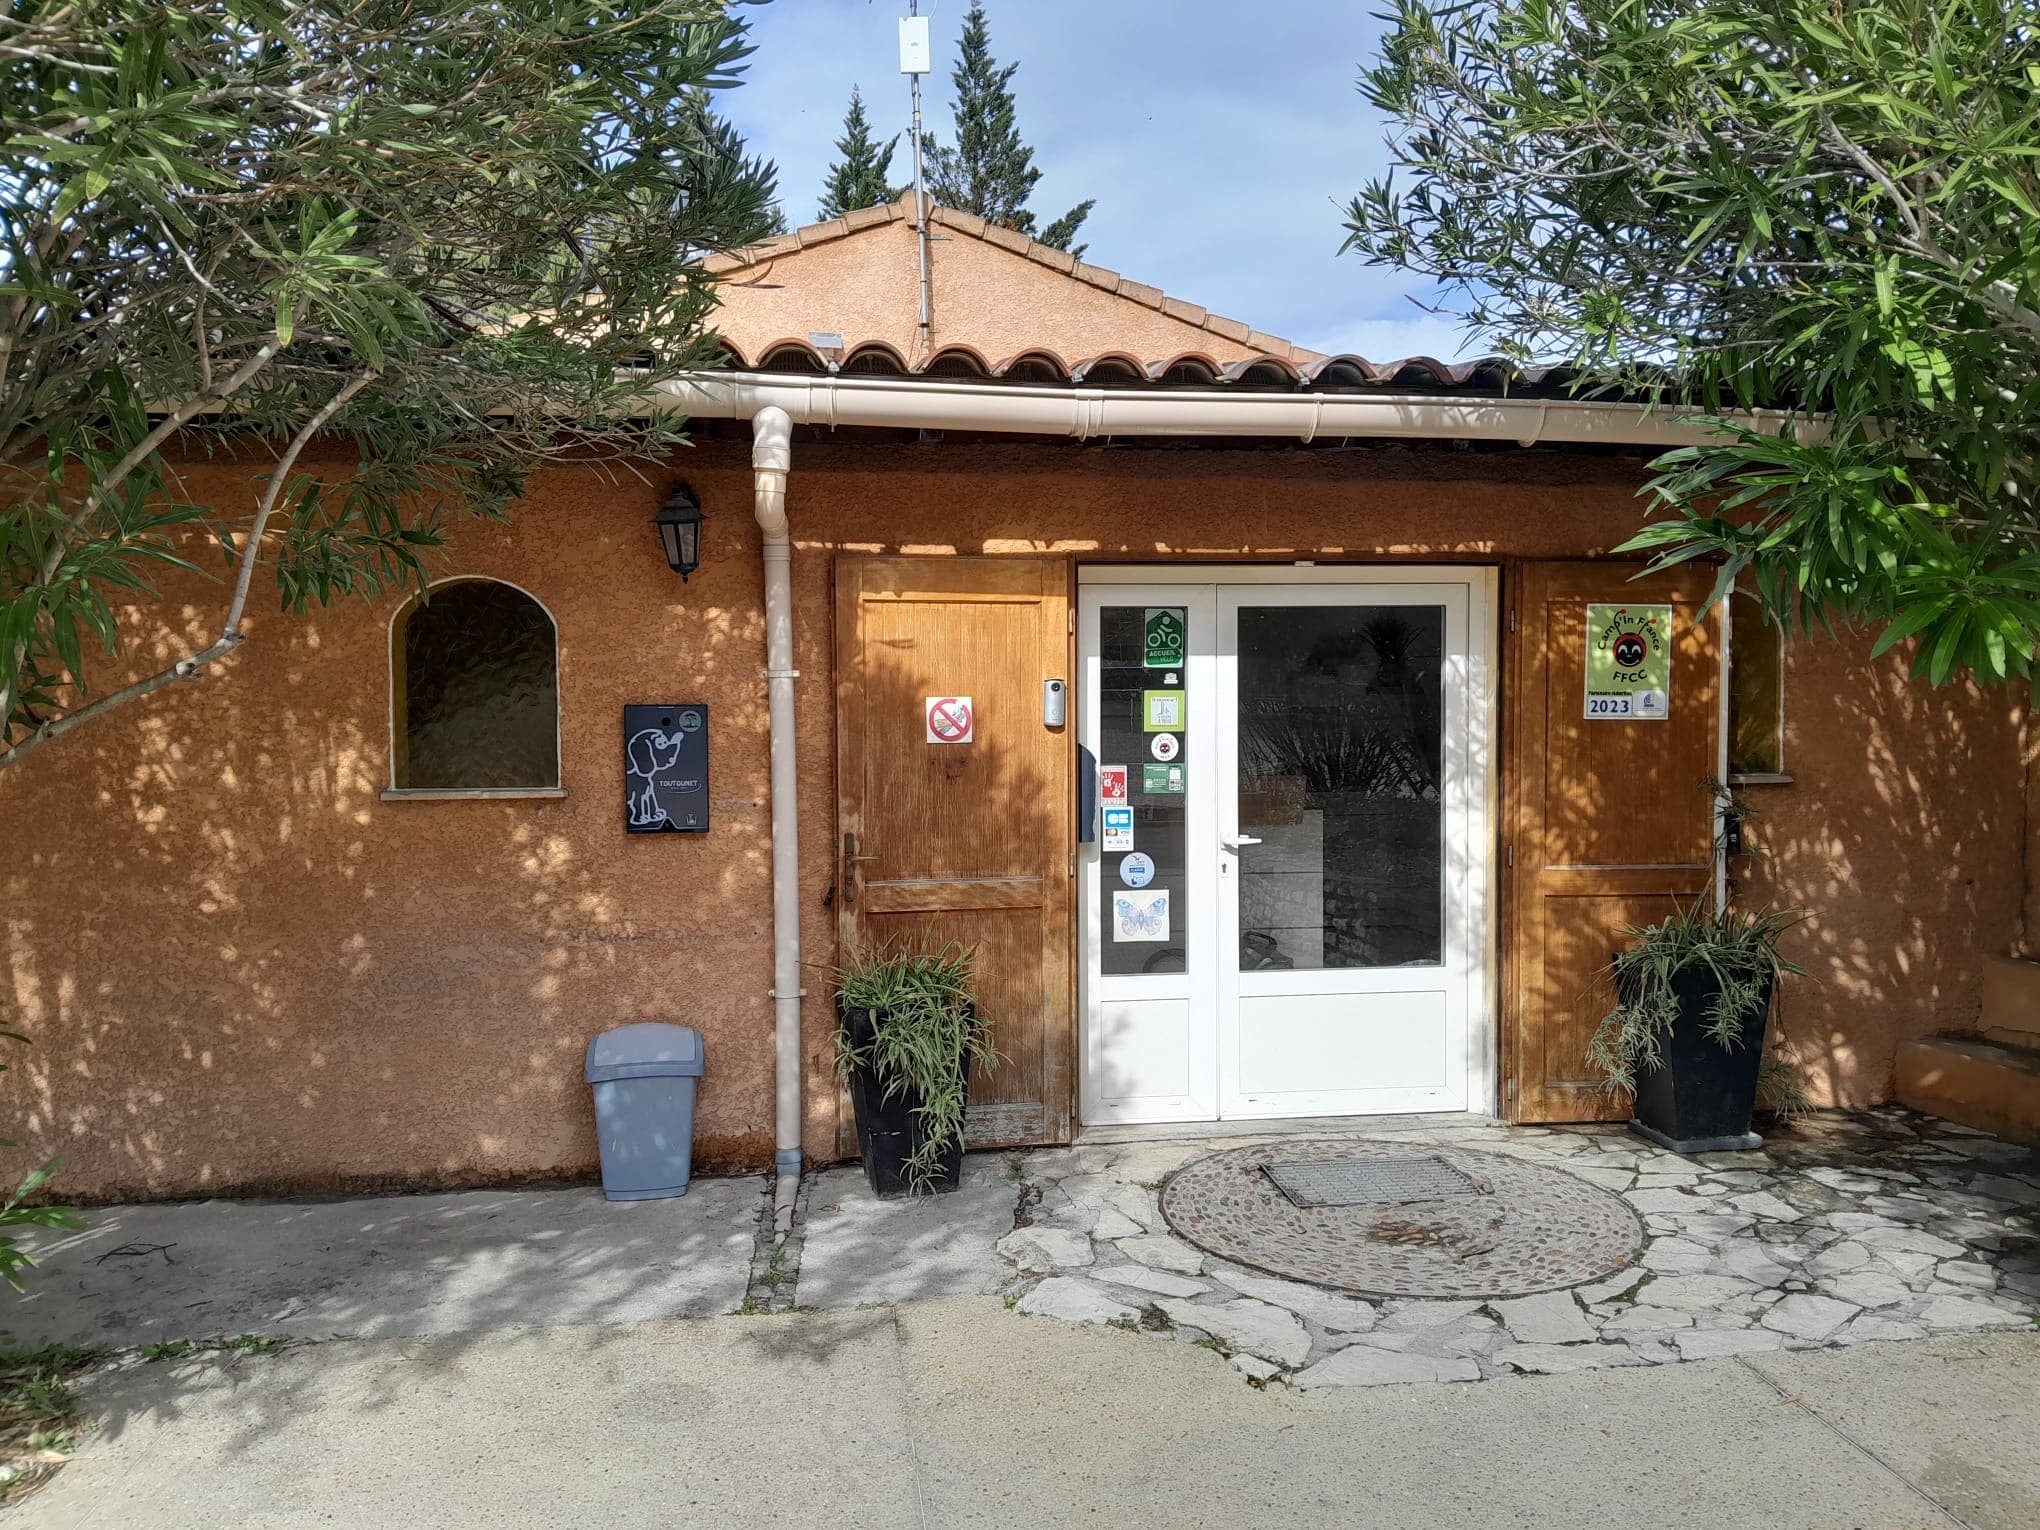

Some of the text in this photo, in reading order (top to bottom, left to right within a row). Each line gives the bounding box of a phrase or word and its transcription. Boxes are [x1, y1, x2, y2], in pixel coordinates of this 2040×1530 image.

[1637, 616, 1660, 651] France
[1149, 649, 1176, 657] ACCUEIL
[1613, 669, 1648, 683] FFCC
[1590, 700, 1630, 713] 2023
